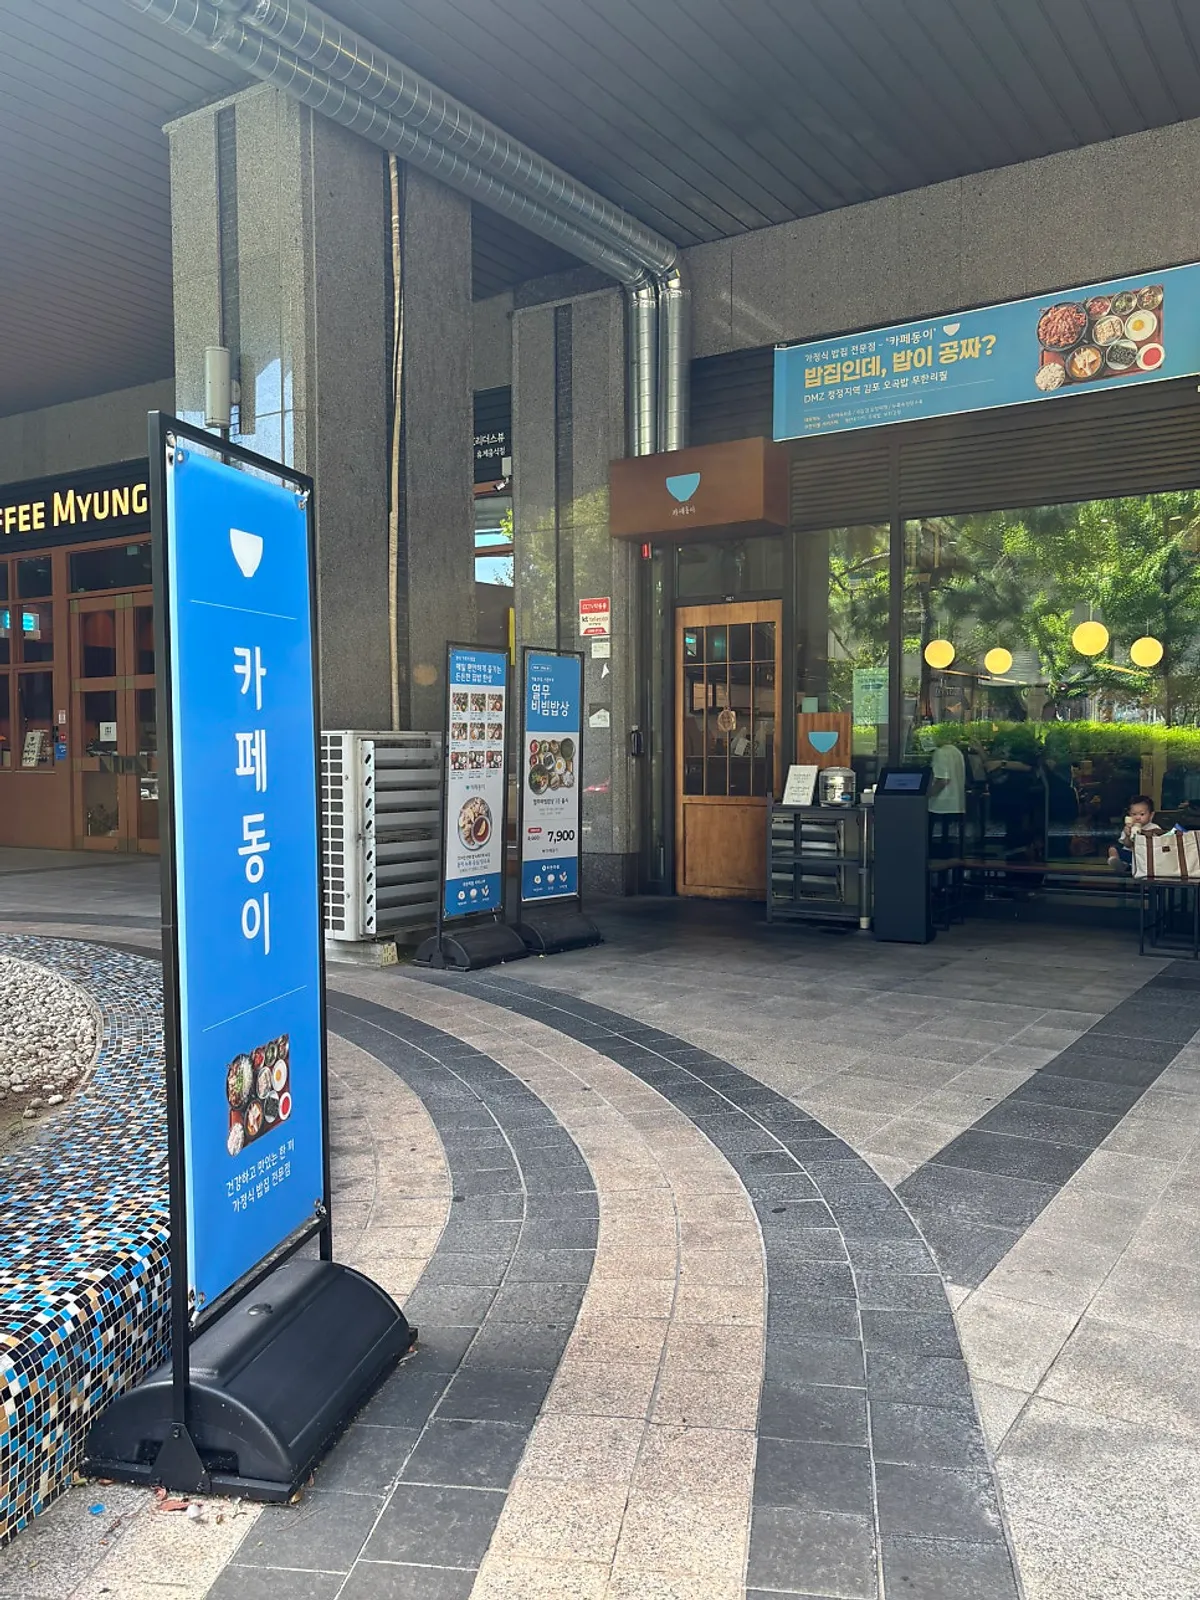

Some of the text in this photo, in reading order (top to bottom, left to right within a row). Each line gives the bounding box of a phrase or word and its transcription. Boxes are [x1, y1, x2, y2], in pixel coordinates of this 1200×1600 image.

[804, 334, 997, 389] 밥집인데, 밥이 공짜?
[805, 350, 829, 362] 가정식
[831, 346, 848, 359] 밥집
[850, 342, 876, 356] 전문점
[803, 391, 825, 404] DMZ
[863, 382, 880, 394] 김포
[883, 377, 909, 390] 오곡밥
[912, 370, 948, 385] 무한리필
[474, 432, 505, 446] 리더스뷰
[0, 483, 148, 535] FEE MYUNG
[531, 683, 551, 700] 열무
[531, 700, 570, 717] 비빔밥상
[233, 646, 271, 956] 카페동이
[547, 829, 575, 844] 7,900
[226, 1165, 257, 1198] 건강하고
[257, 1152, 278, 1176] 맛있는
[279, 1144, 286, 1160] 한
[232, 1160, 291, 1213] 가정식 밥집 전문점
